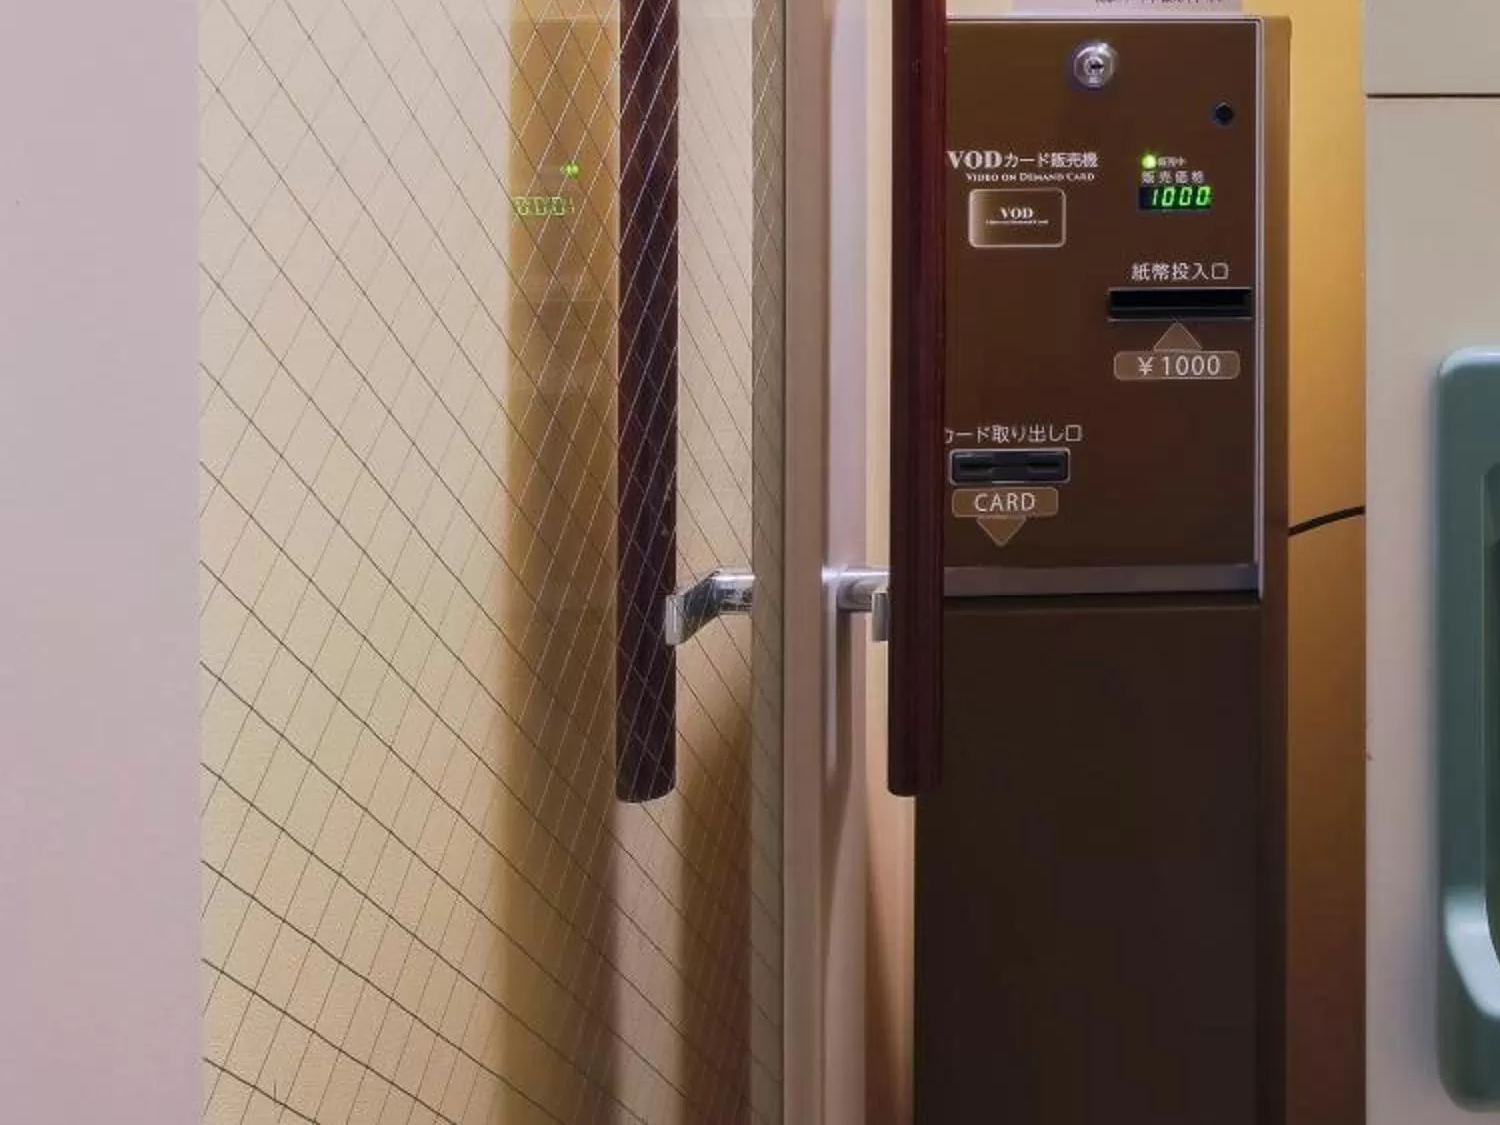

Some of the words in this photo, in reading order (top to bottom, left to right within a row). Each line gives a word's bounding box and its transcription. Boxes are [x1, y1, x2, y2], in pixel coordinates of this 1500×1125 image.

[1152, 186, 1211, 207] 1000
[1000, 206, 1034, 219] VOD
[1131, 262, 1229, 281] 紙幣投入口
[974, 492, 1036, 513] CARD
